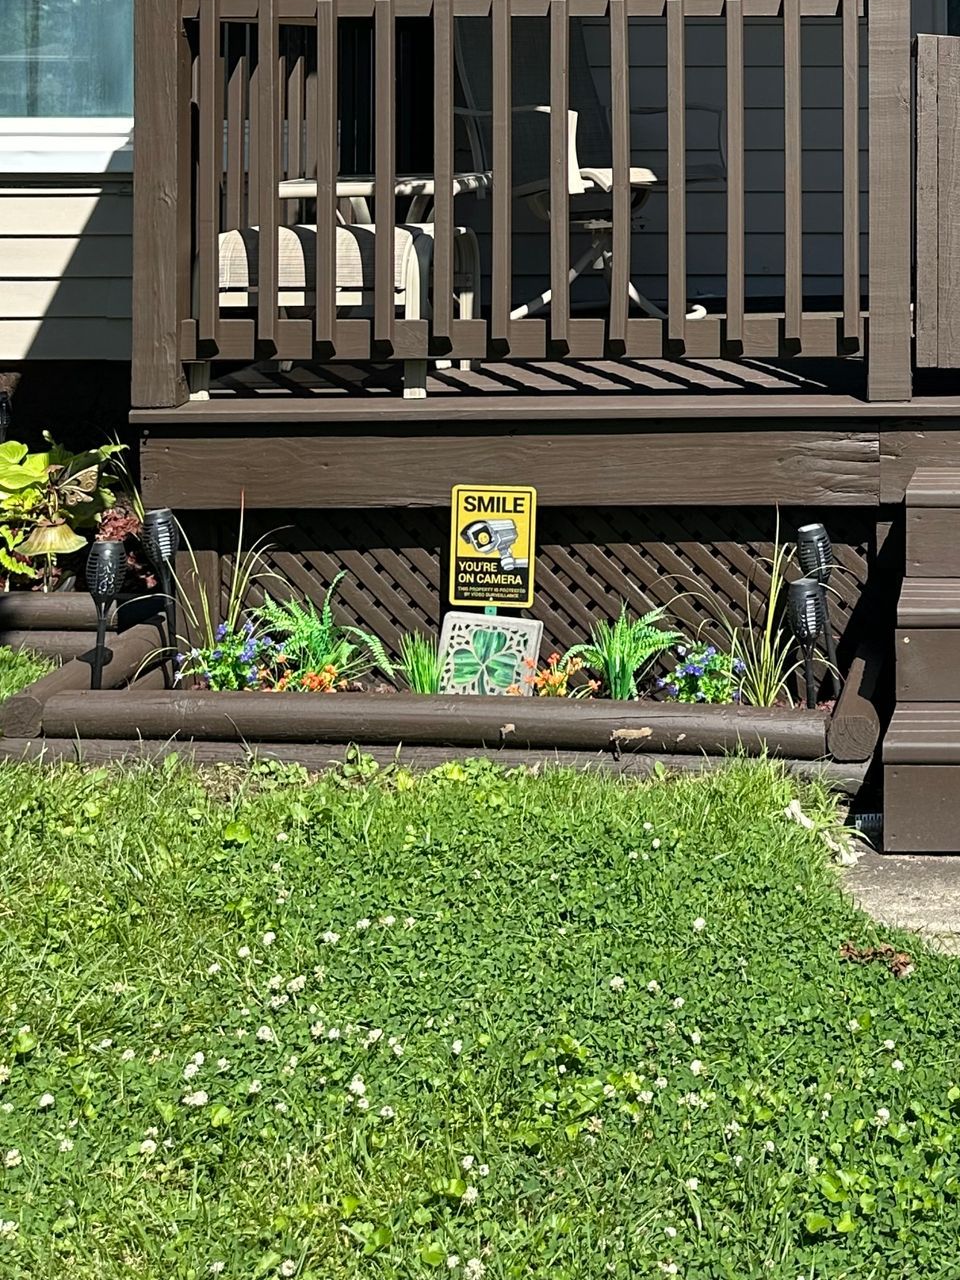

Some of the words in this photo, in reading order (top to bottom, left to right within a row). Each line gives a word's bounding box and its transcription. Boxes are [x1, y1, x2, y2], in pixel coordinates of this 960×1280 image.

[463, 495, 525, 514] SMILE
[458, 561, 498, 572] YOU'RE
[458, 573, 475, 583] ON
[476, 574, 522, 585] CAMERA
